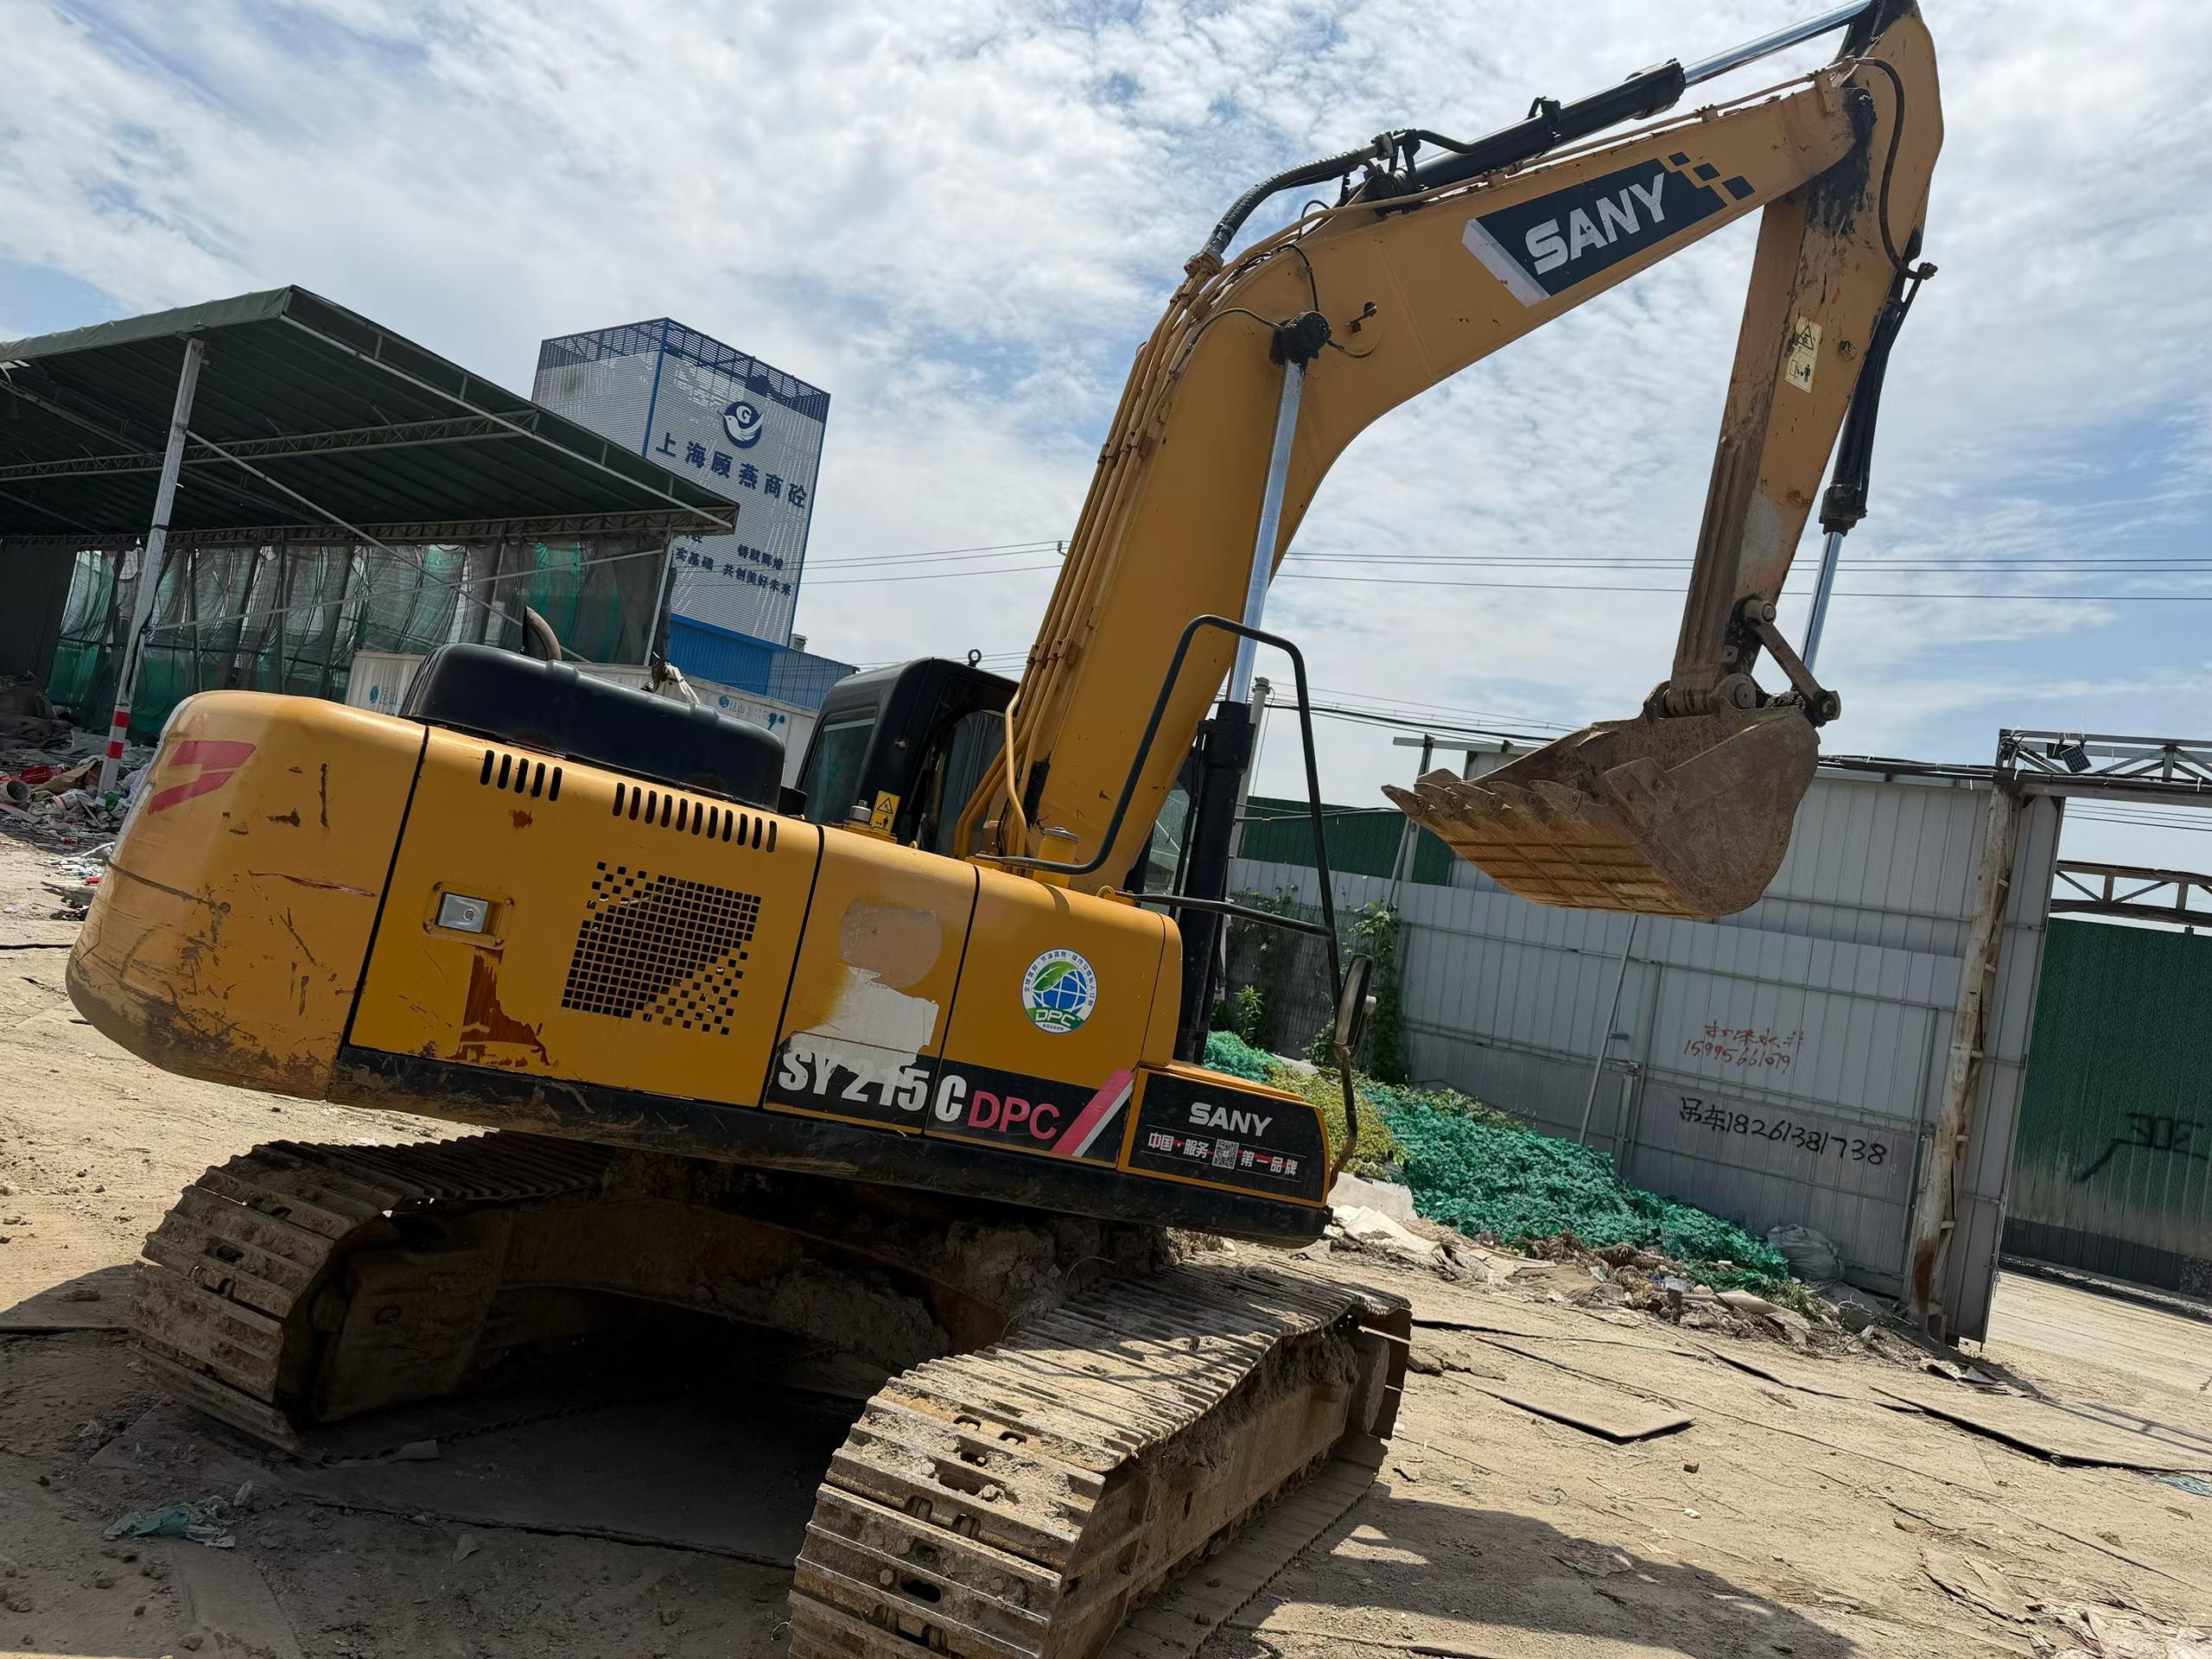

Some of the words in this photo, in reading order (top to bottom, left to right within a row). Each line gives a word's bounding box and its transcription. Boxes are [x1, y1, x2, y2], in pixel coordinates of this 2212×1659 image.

[1525, 173, 1666, 276] SANY
[1036, 1009, 1076, 1027] DPC
[967, 1090, 1060, 1140] DPC
[1189, 1102, 1273, 1137] SANY
[1240, 1149, 1299, 1176] 第一品牌
